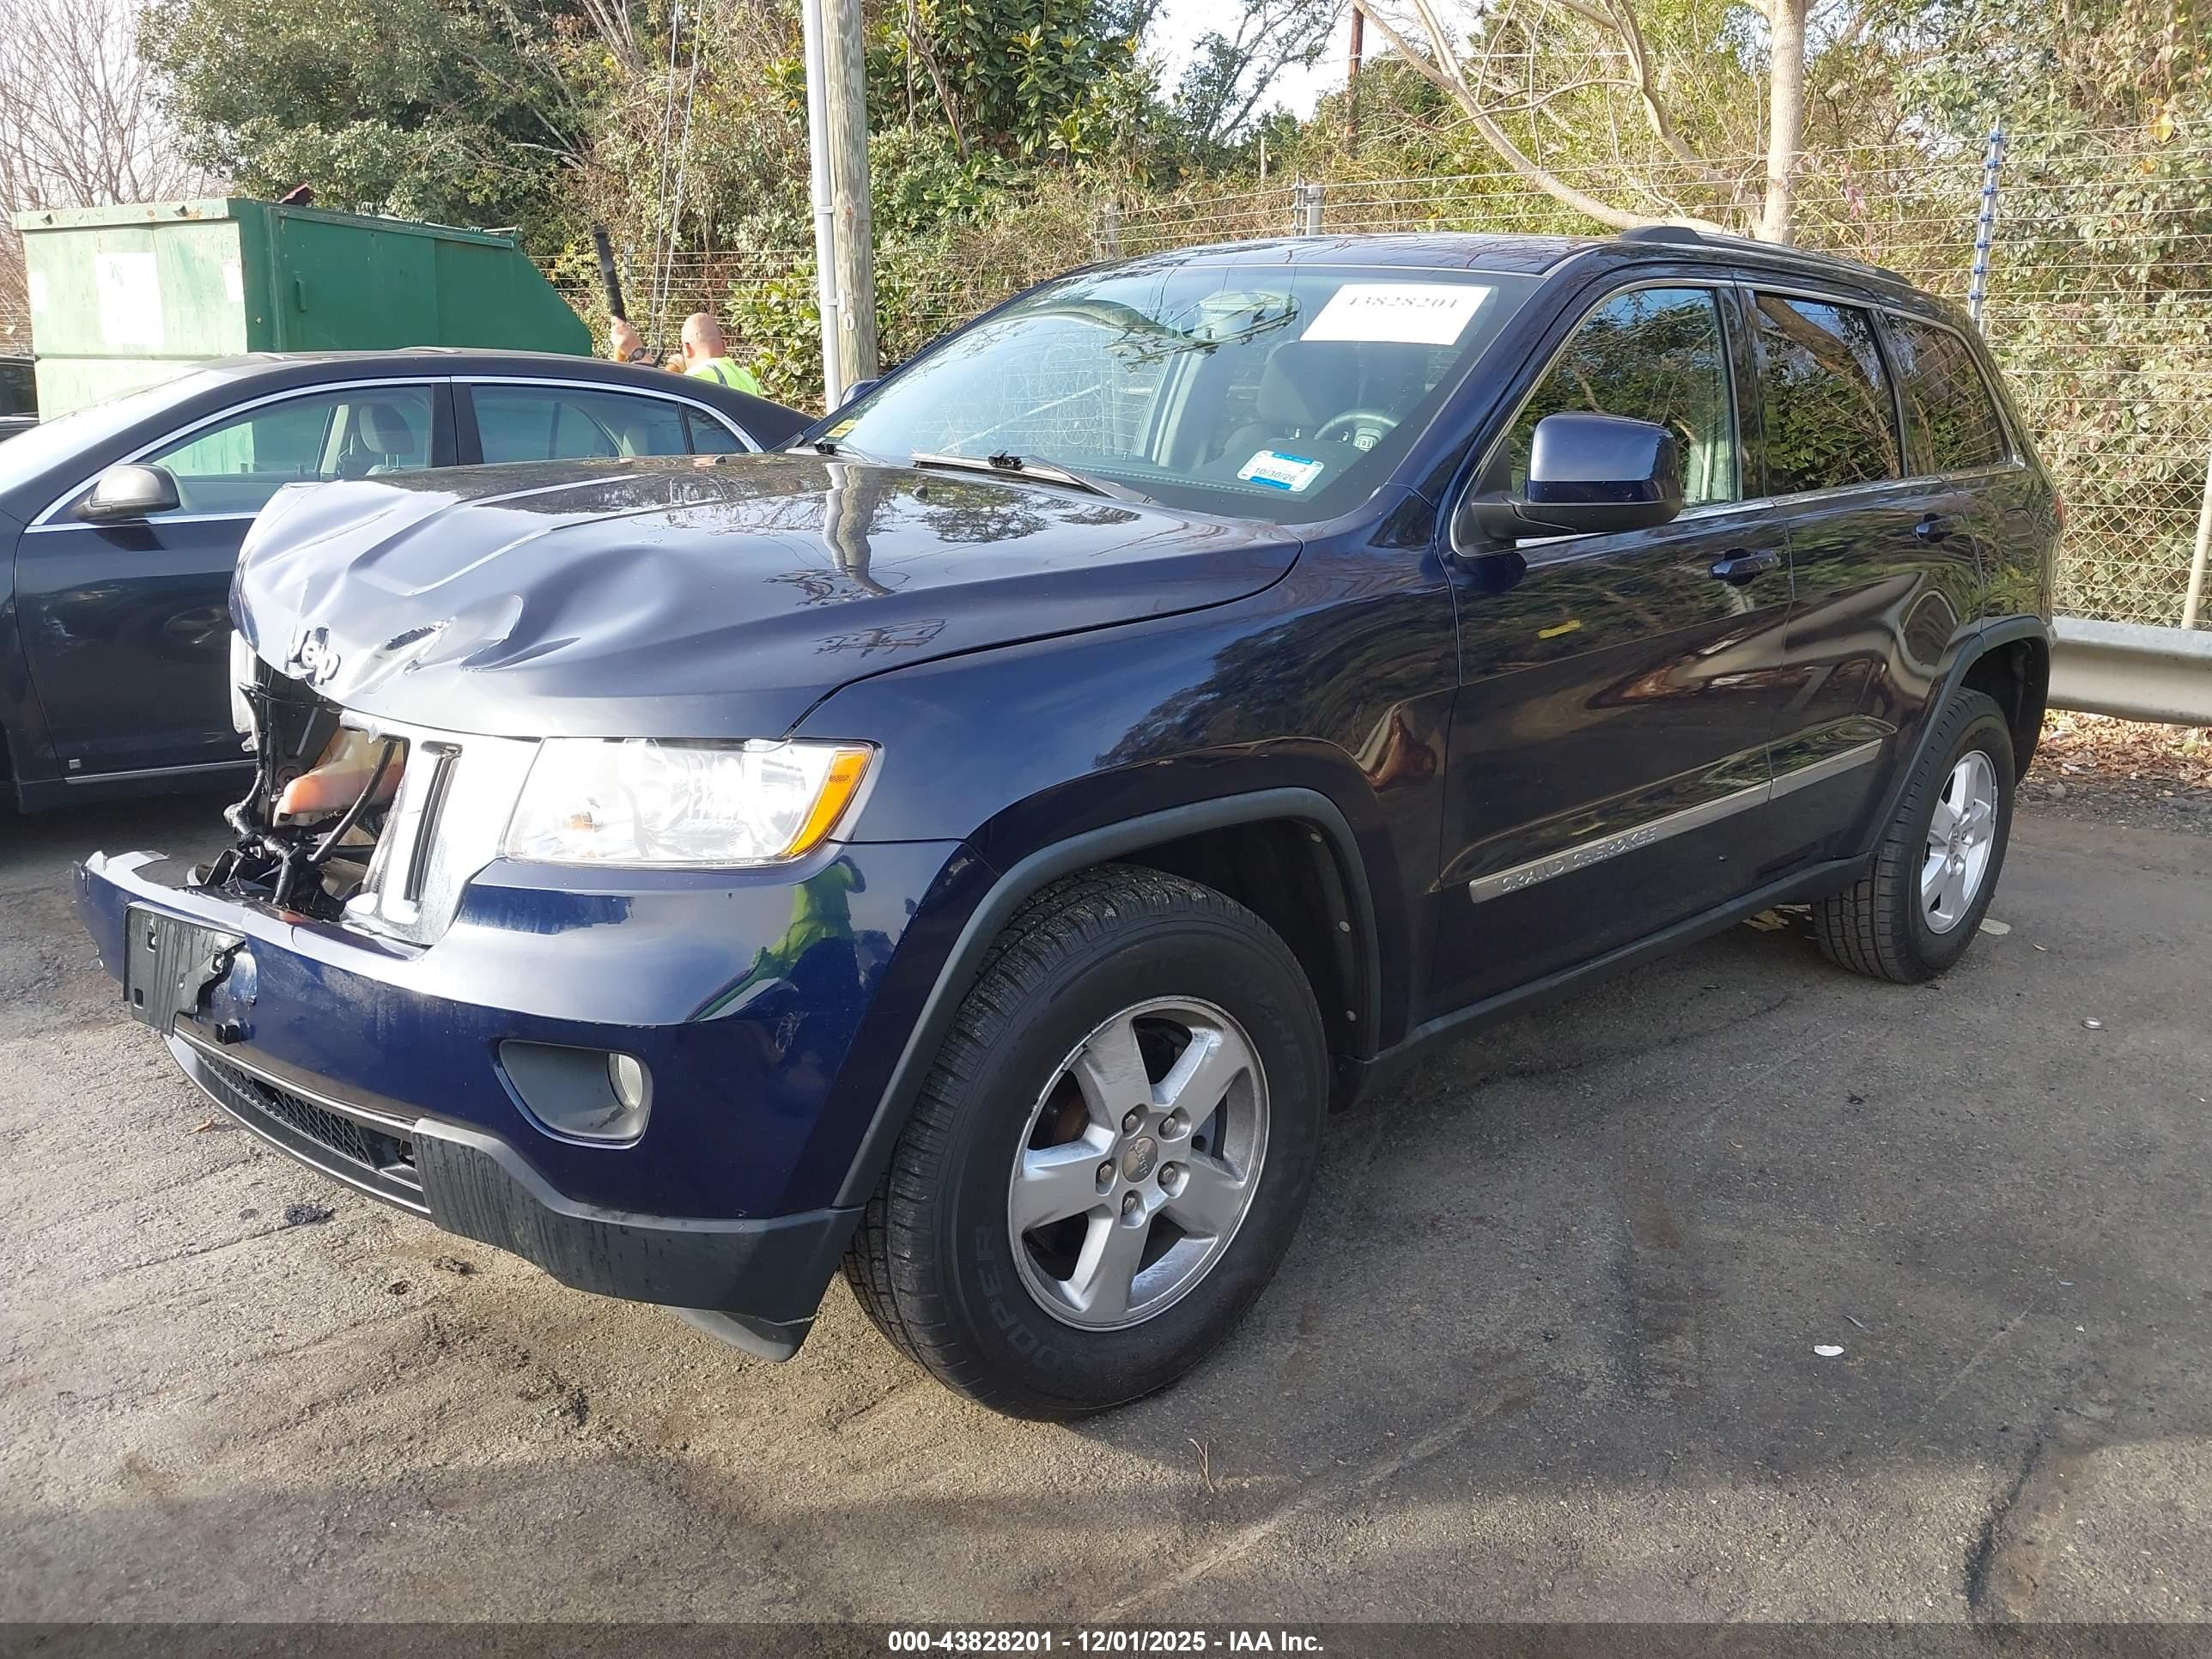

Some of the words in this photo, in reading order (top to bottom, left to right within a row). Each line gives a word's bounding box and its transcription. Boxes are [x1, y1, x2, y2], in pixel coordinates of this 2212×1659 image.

[1254, 466, 1297, 483] 10/30/26
[1500, 859, 1566, 892] GRAND
[1572, 827, 1658, 868] CHEROKEE
